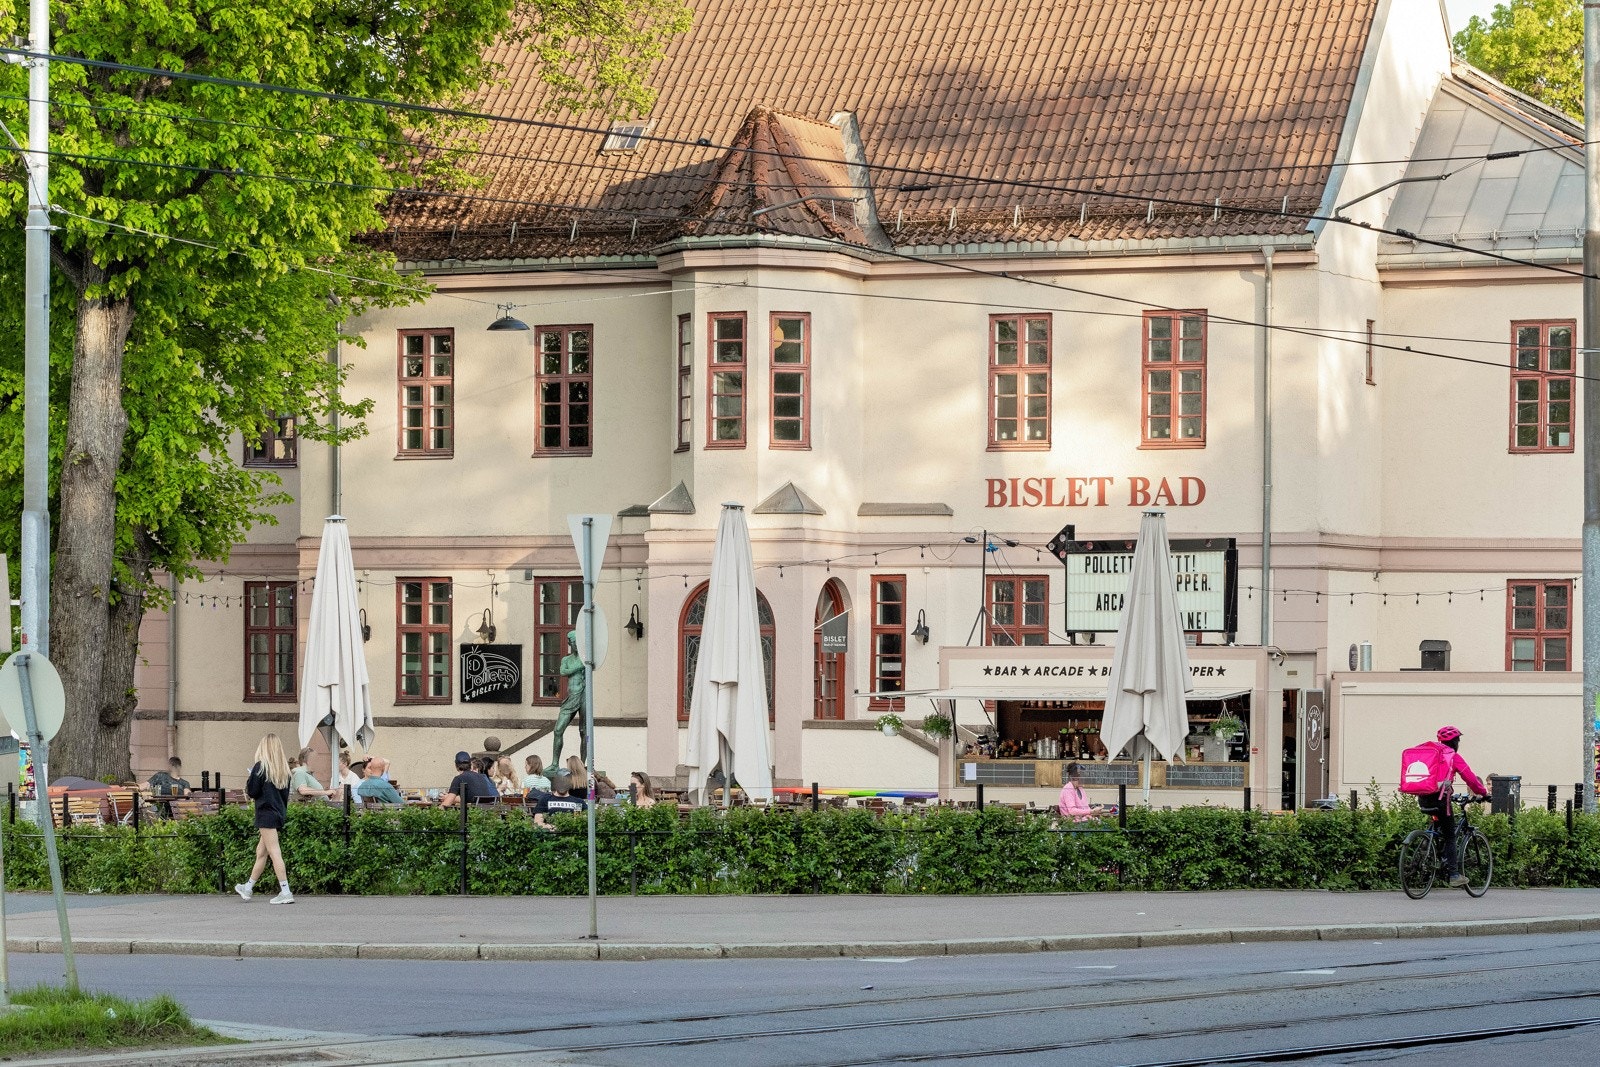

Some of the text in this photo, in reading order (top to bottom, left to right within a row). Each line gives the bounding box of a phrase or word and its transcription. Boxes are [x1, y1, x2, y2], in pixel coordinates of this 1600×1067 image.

[985, 476, 1206, 507] BISLET BAD
[1170, 555, 1195, 572] TT!
[1176, 573, 1211, 592] PPER.
[1096, 593, 1125, 611] ARCA
[994, 666, 1018, 676] BAR
[1034, 666, 1084, 676] ARCADE
[471, 682, 502, 698] BISLETT
